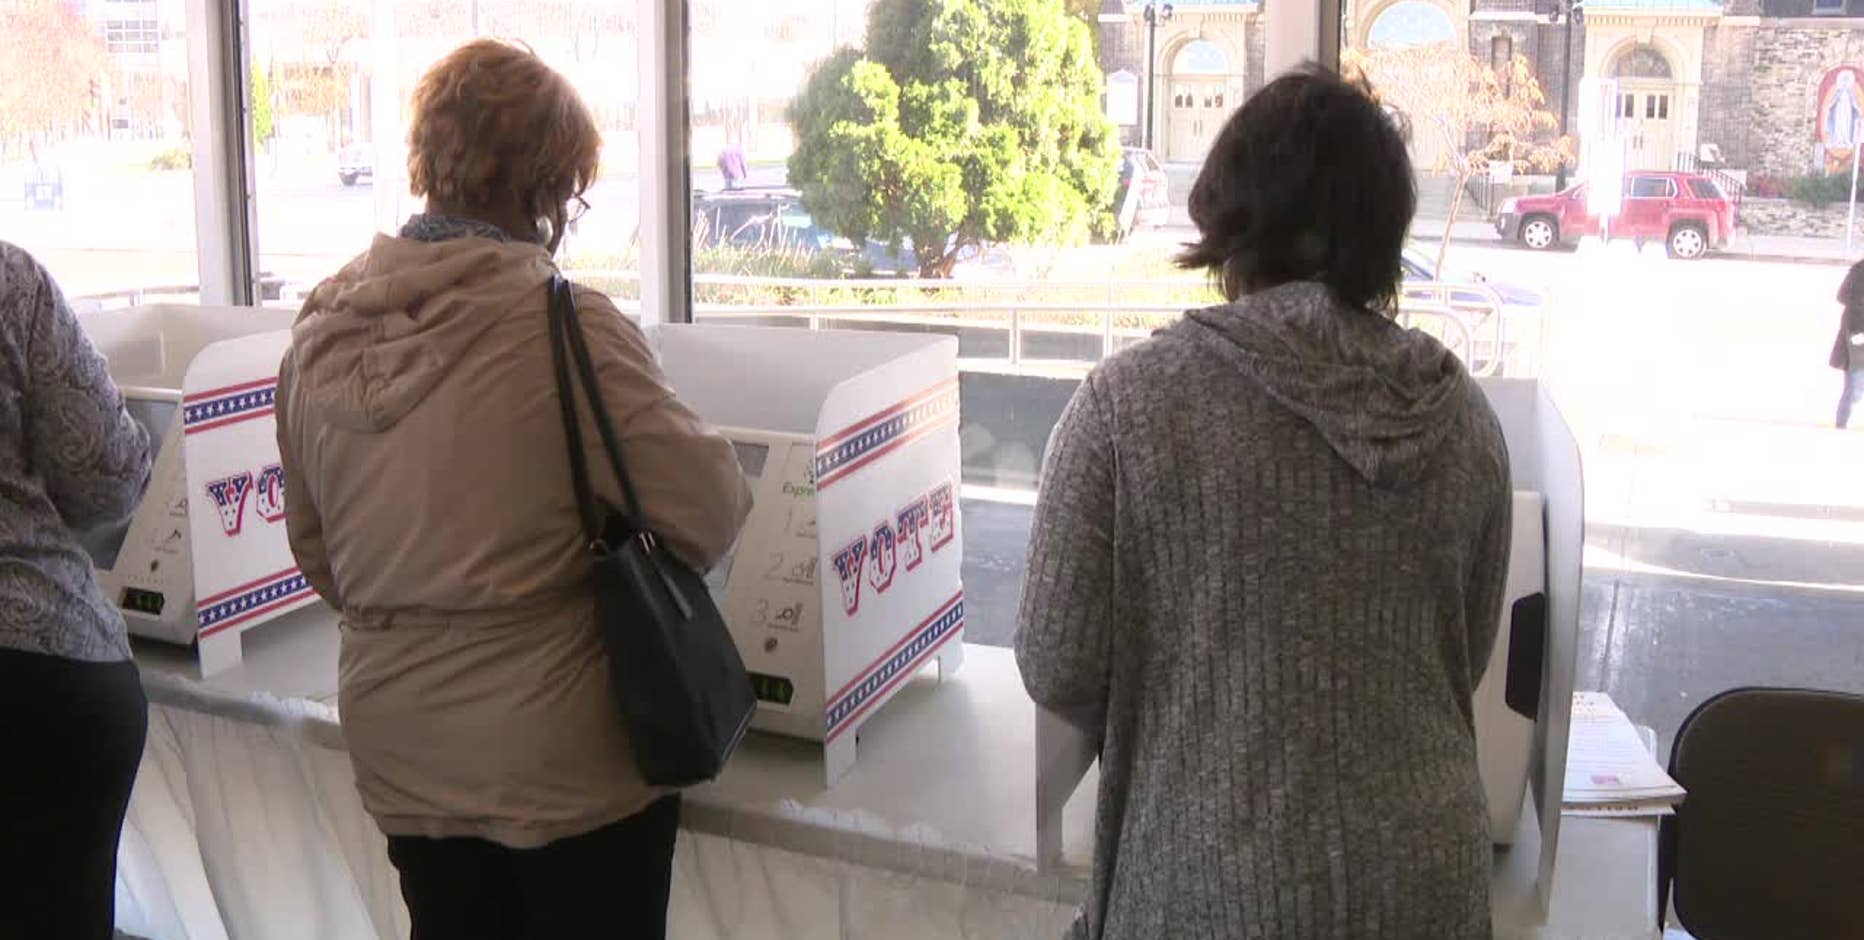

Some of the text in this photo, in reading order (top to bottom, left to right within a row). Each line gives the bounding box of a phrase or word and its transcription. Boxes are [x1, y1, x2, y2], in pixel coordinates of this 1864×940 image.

[832, 480, 954, 617] VOTE
[763, 552, 785, 575] 2
[752, 598, 770, 625] 3
